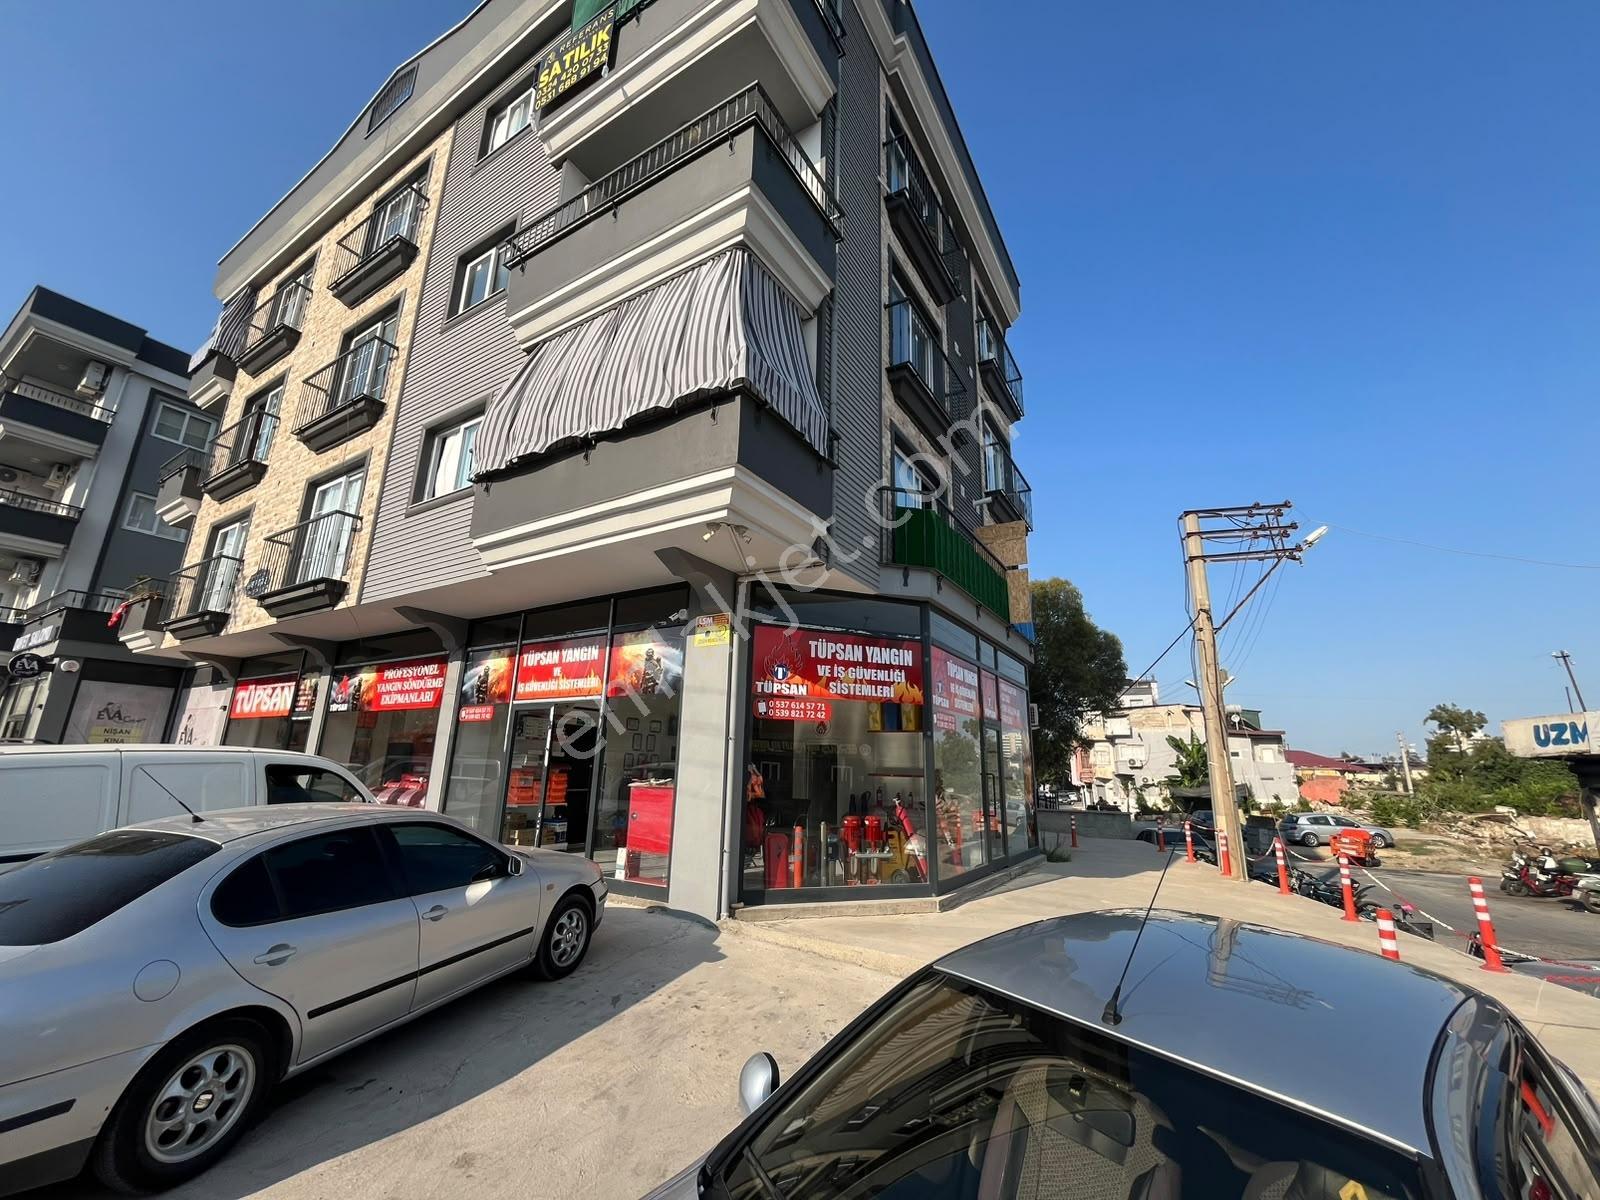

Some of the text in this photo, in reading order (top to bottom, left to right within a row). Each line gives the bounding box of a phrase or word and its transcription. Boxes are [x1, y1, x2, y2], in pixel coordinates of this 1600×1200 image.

[560, 9, 614, 53] REFERANS
[539, 23, 612, 88] SATILIK
[560, 64, 579, 82] 420
[523, 645, 598, 667] TÜPSAN YANGIN
[808, 639, 913, 667] TÜPSAN YANGIN
[383, 664, 439, 680] PROFESYONEL
[553, 667, 562, 677] VE
[817, 665, 906, 683] VE İŞ GÜVENLİĞİ
[377, 676, 444, 692] YANGIN SÖNDÜRME
[755, 678, 807, 696] TÜPSAN
[829, 681, 895, 698] SİSTEMLERİ
[235, 684, 295, 713] TÜPSAN
[380, 690, 433, 705] EKİPMANLARI
[775, 701, 790, 709] 537
[775, 709, 790, 717] 539
[790, 710, 804, 718] 821
[816, 711, 825, 719] 42
